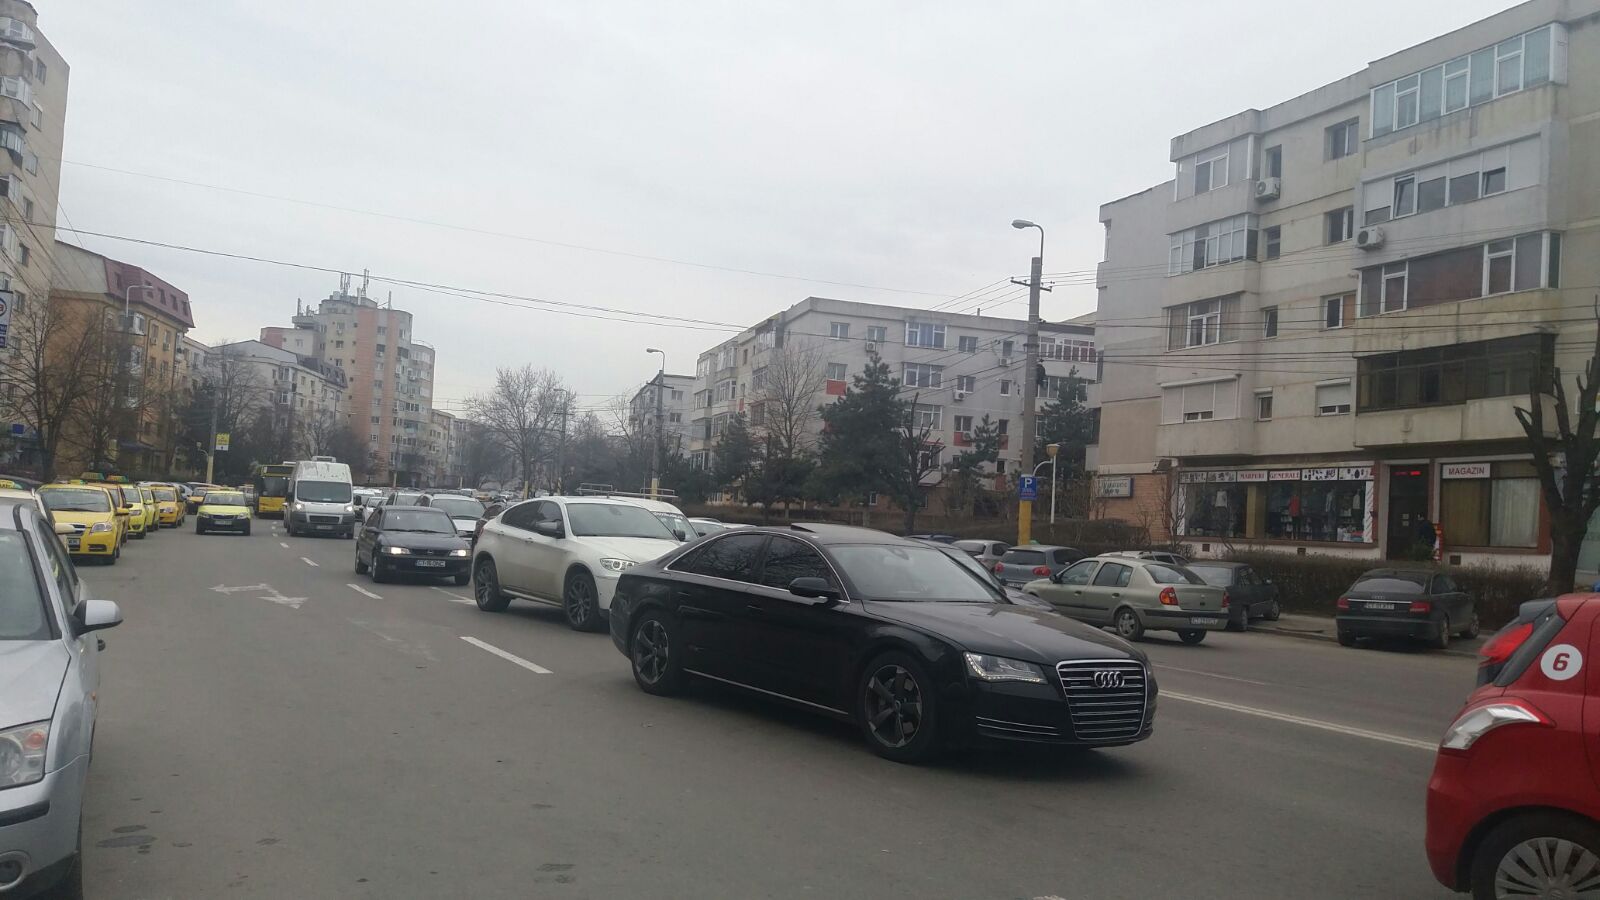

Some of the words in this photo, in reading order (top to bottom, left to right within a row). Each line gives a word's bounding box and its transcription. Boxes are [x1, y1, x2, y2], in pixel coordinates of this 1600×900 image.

[1269, 471, 1299, 479] GENERALE
[1448, 467, 1485, 475] MAGAZIN
[1024, 477, 1033, 488] P
[1553, 652, 1570, 671] 6
